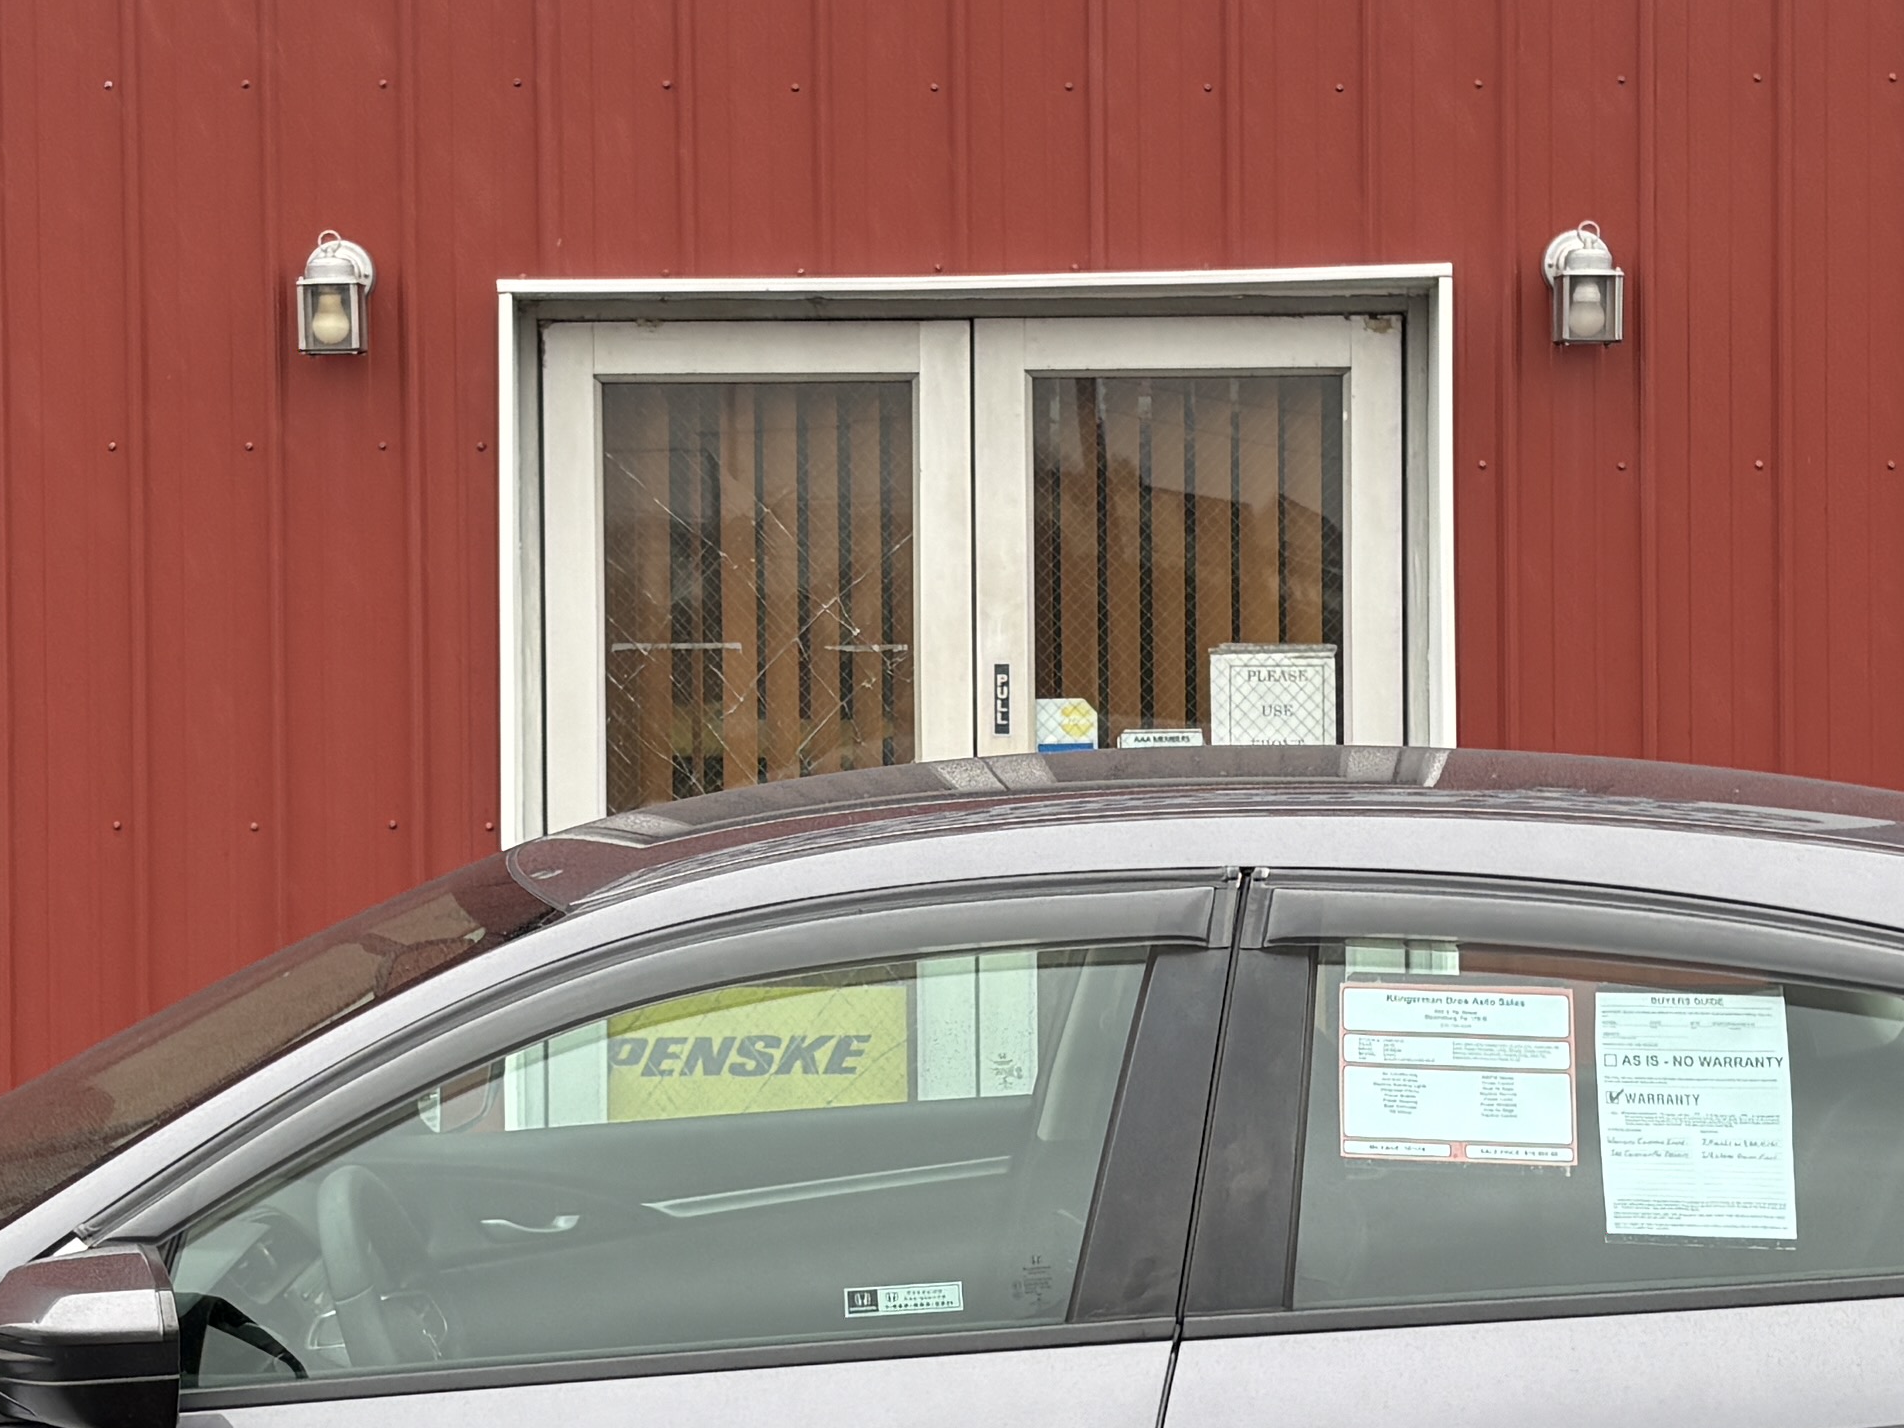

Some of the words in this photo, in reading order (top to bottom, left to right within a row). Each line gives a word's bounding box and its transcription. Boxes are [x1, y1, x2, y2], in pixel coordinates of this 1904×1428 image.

[1247, 669, 1308, 682] PLEASE
[996, 673, 1008, 725] PULL
[1262, 704, 1294, 717] USE
[607, 1034, 873, 1078] PENSKE
[1622, 1054, 1641, 1067] AS
[1646, 1054, 1659, 1067] IS
[1673, 1055, 1694, 1068] NO
[1698, 1055, 1784, 1069] WARRANTY
[1624, 1092, 1701, 1107] WARRANTY
